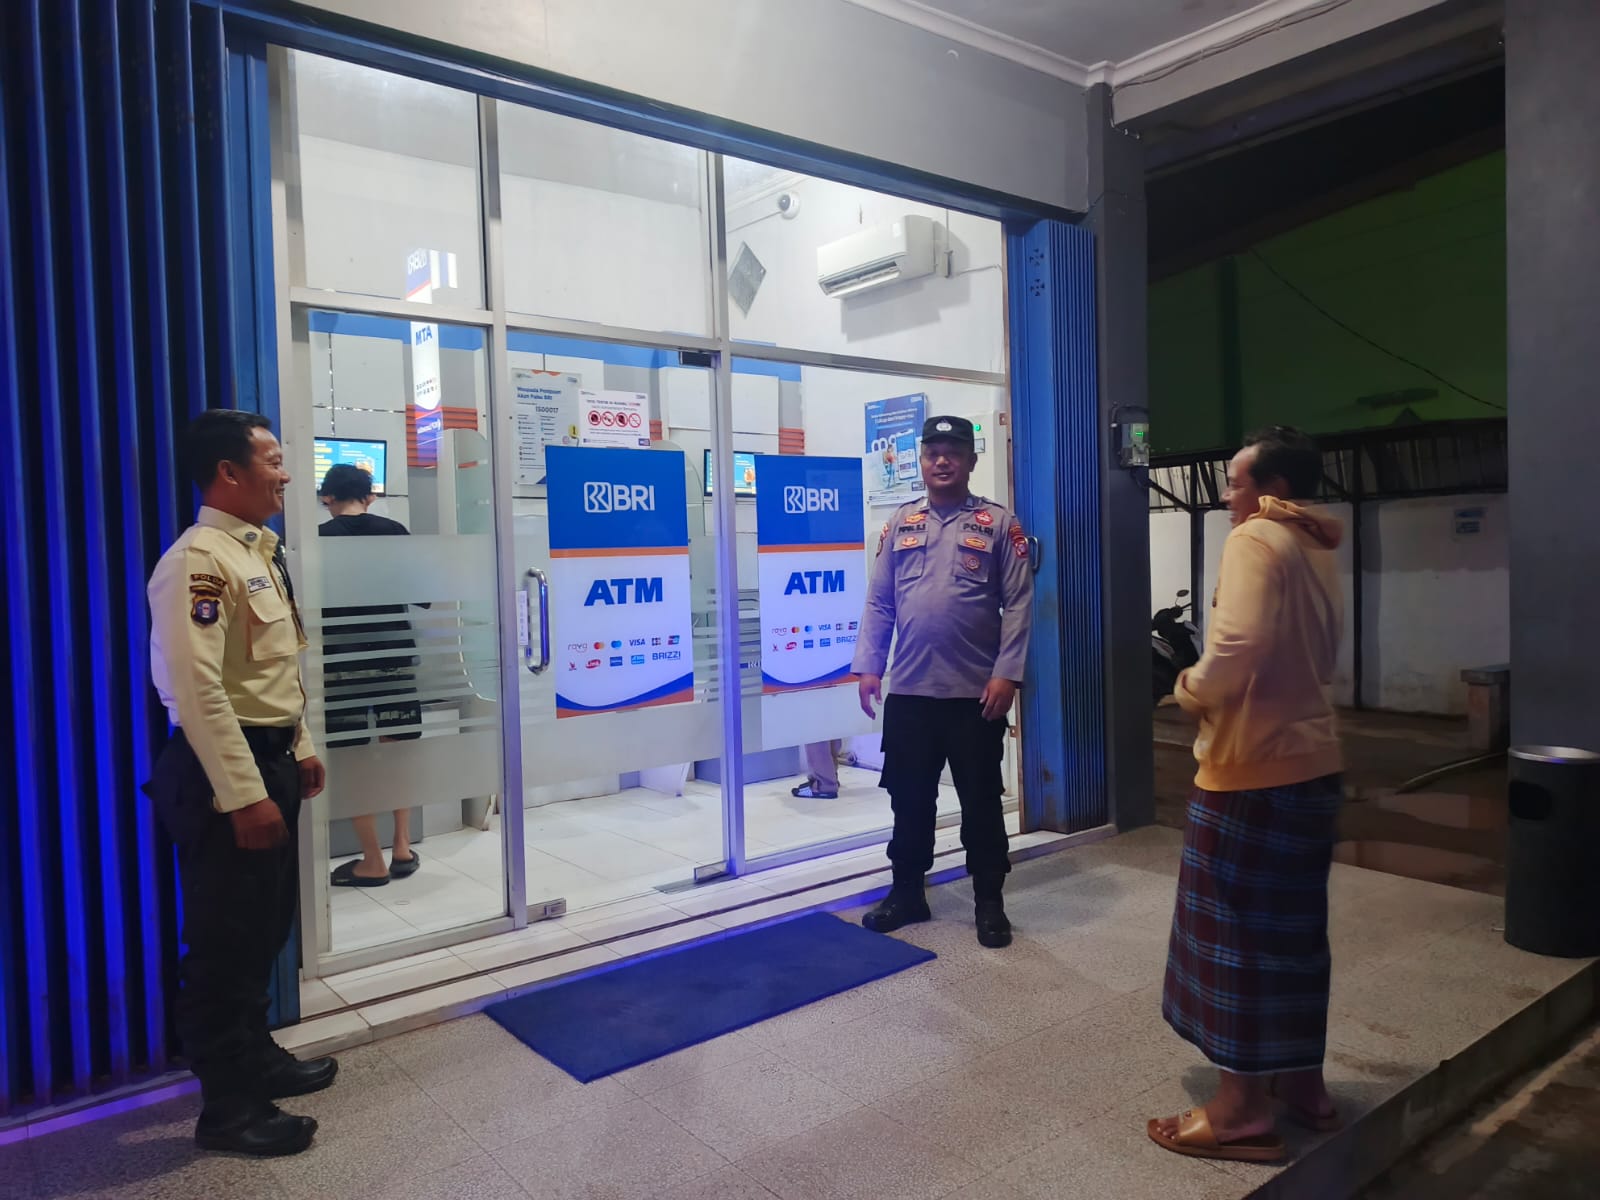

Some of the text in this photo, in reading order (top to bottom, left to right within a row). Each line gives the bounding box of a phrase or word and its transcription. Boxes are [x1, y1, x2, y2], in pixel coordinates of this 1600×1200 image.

[613, 485, 655, 511] BRI
[805, 488, 839, 512] BRI
[963, 523, 993, 535] POLRI
[193, 575, 224, 586] POLDA
[784, 570, 845, 595] ATM
[584, 577, 663, 606] ATM
[629, 638, 646, 647] VISA
[652, 651, 681, 661] BRIZZI
